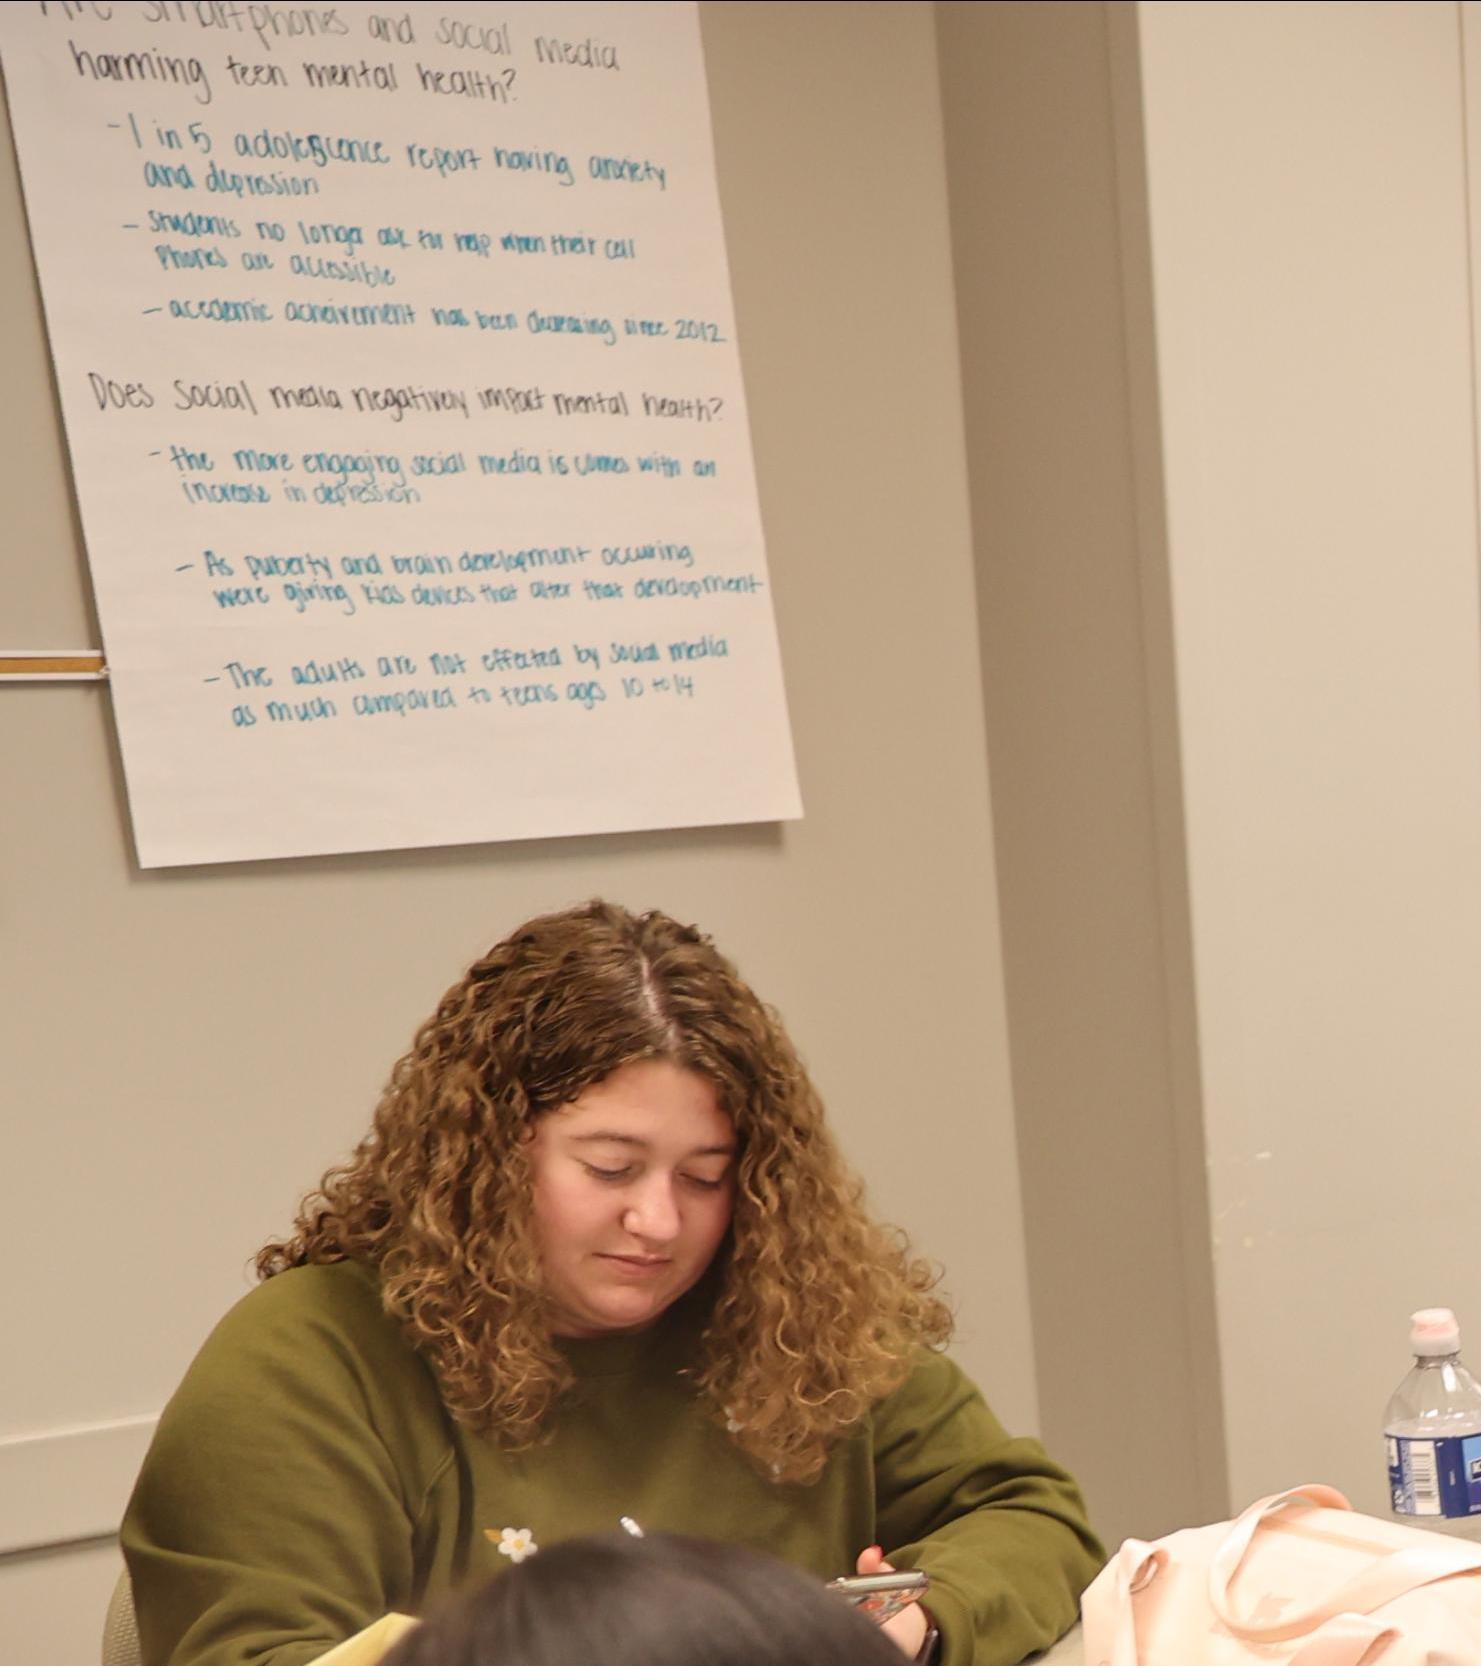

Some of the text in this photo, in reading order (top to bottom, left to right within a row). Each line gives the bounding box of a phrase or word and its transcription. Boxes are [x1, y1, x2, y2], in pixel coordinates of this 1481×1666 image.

[368, 14, 415, 44] and
[435, 16, 512, 56] social
[69, 40, 518, 105] harming teen mental health?
[152, 120, 183, 150] in
[189, 122, 212, 154] 5
[407, 142, 482, 178] report
[493, 146, 575, 186] having
[588, 154, 667, 190] anxiety
[144, 160, 320, 198] and depression
[256, 221, 285, 242] no
[500, 231, 547, 254] when
[550, 233, 598, 256] their
[604, 238, 635, 260] cell
[241, 252, 275, 272] are
[431, 306, 469, 328] has
[476, 308, 518, 332] been
[624, 318, 670, 337] since
[675, 319, 727, 343] 2012
[87, 371, 154, 411] Does
[269, 383, 344, 410] media
[352, 383, 470, 422] negatively
[477, 386, 546, 415] impact
[552, 391, 630, 418] mental
[641, 392, 725, 423] health?
[233, 449, 294, 473] more
[303, 450, 407, 488] engaging
[410, 451, 466, 477] social
[478, 448, 543, 476] media
[548, 451, 569, 476] is
[637, 451, 681, 479] with
[693, 459, 717, 477] an
[181, 474, 421, 507] increase in depression
[203, 550, 234, 577] As
[244, 553, 333, 581] puberty
[340, 553, 384, 576] and
[390, 552, 454, 576] brain
[459, 546, 593, 574] development
[213, 586, 270, 609] were
[283, 578, 356, 616] giving
[360, 580, 406, 605] kids
[411, 582, 476, 606] devices
[479, 582, 519, 604] that
[582, 578, 624, 601] that
[633, 572, 764, 600] development
[222, 660, 273, 690] The
[290, 657, 366, 686] adults
[377, 654, 417, 678] are
[481, 647, 563, 673] effected
[572, 644, 601, 671] by
[667, 634, 729, 663] media
[231, 703, 257, 728] as
[265, 697, 338, 723] much
[351, 686, 457, 717] compared
[468, 686, 492, 705] to
[499, 683, 559, 707] teens
[567, 679, 606, 711] ages
[621, 677, 644, 700] 10
[673, 673, 694, 697] 14
